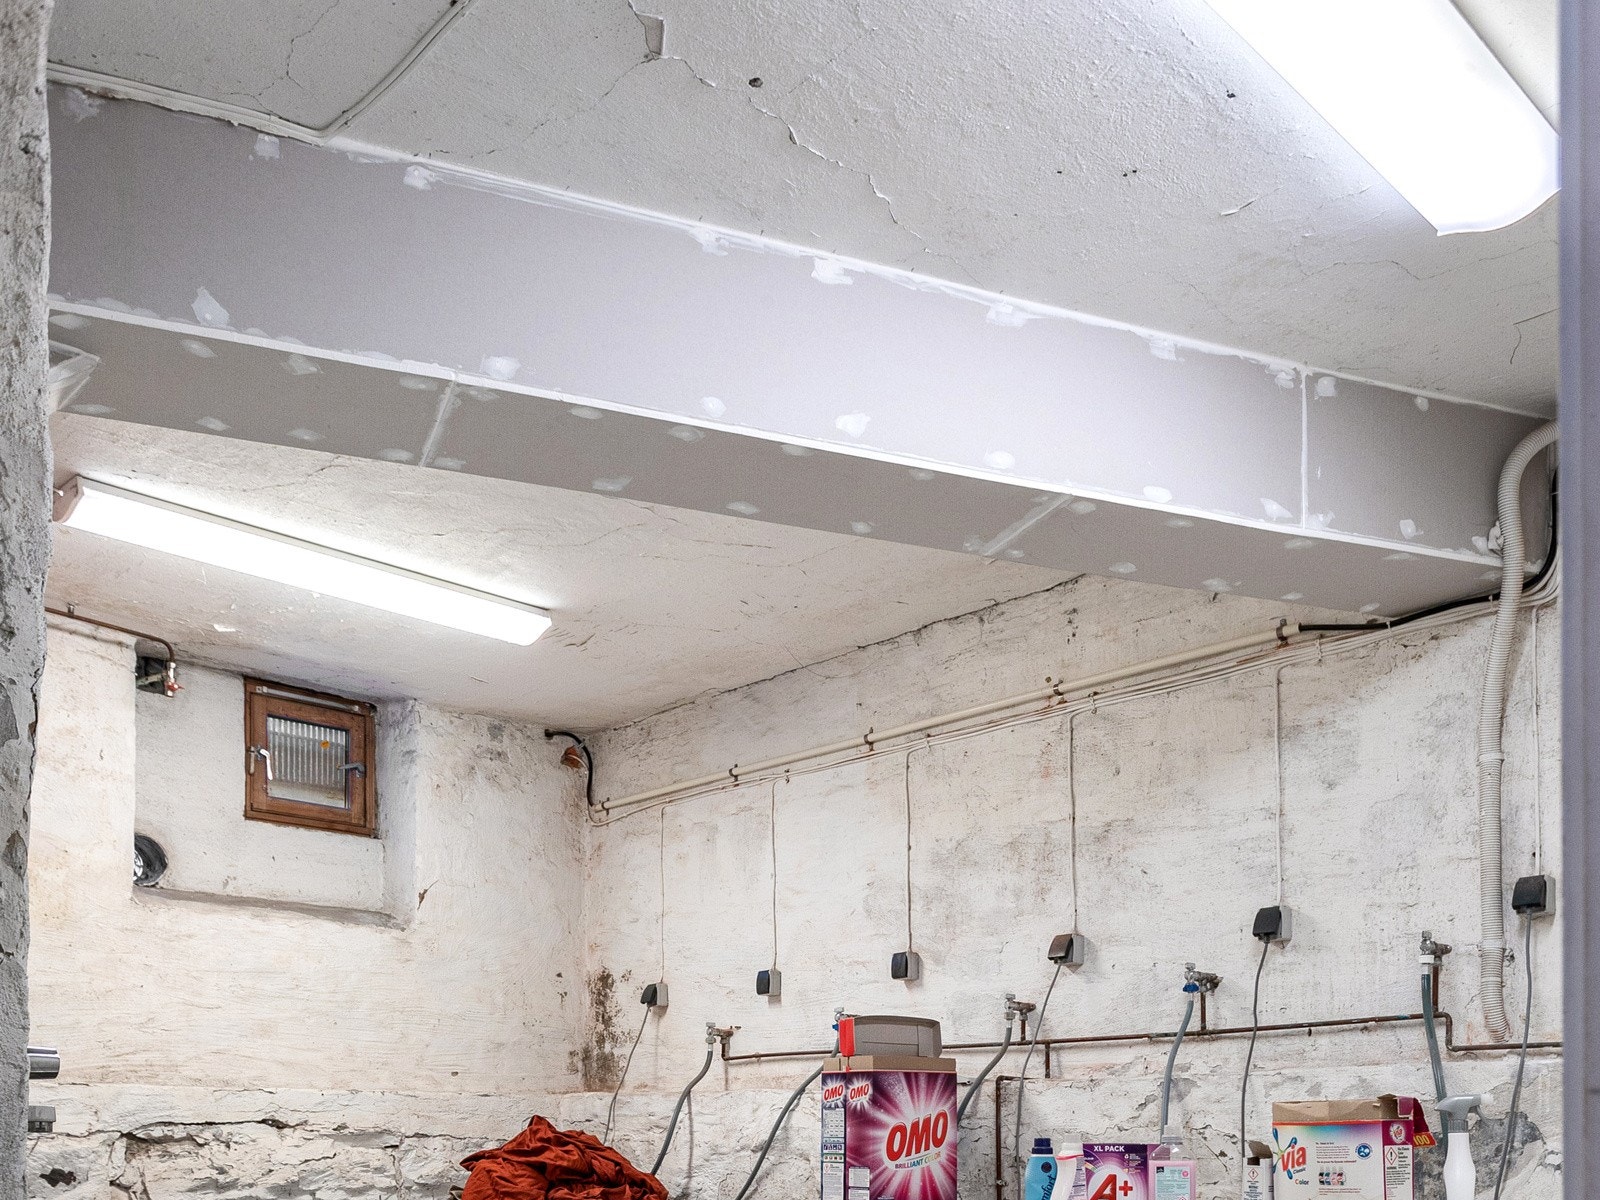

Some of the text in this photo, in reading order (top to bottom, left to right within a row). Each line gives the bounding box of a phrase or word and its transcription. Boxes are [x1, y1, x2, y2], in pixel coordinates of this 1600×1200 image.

[824, 1085, 843, 1101] OMO
[850, 1083, 869, 1100] OMO
[886, 1109, 948, 1161] OMO
[1414, 1135, 1430, 1145] 100
[895, 1159, 923, 1169] BRILLIANT
[1281, 1144, 1306, 1172] via
